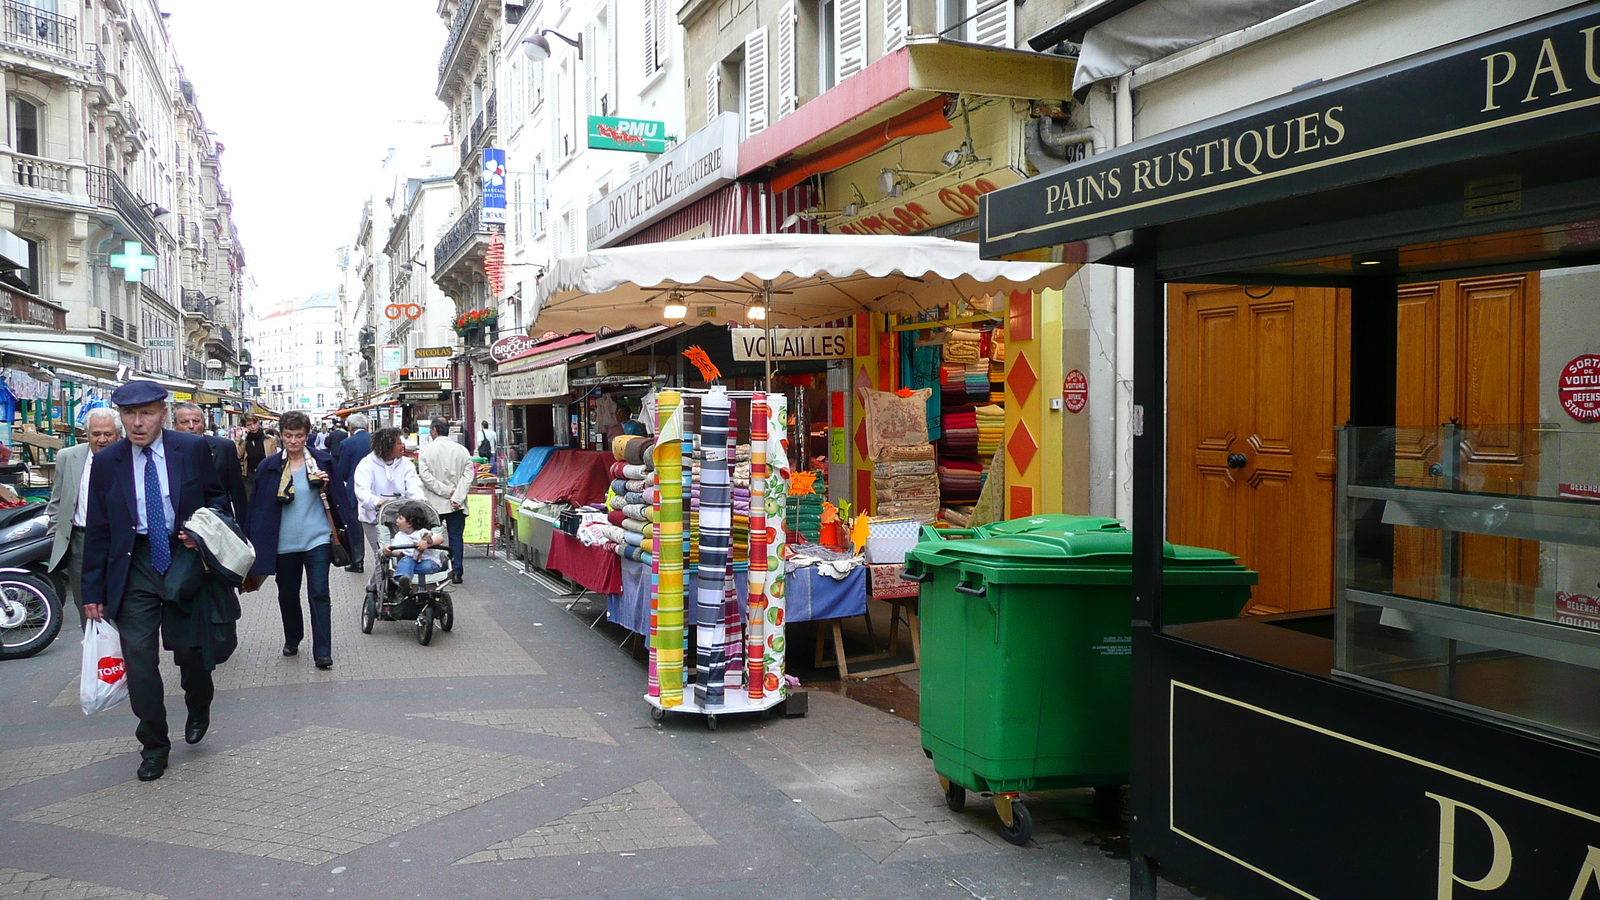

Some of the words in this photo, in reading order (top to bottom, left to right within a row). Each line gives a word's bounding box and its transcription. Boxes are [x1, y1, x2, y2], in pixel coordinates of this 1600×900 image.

[617, 120, 658, 137] PMU
[1045, 167, 1122, 215] PAINS
[1132, 106, 1346, 194] RUSTIQUES
[608, 160, 674, 233] BOUCHERIE
[674, 147, 722, 195] CHARCUTERIE
[416, 347, 451, 357] NICOLAS
[743, 335, 846, 357] VOLAILLES
